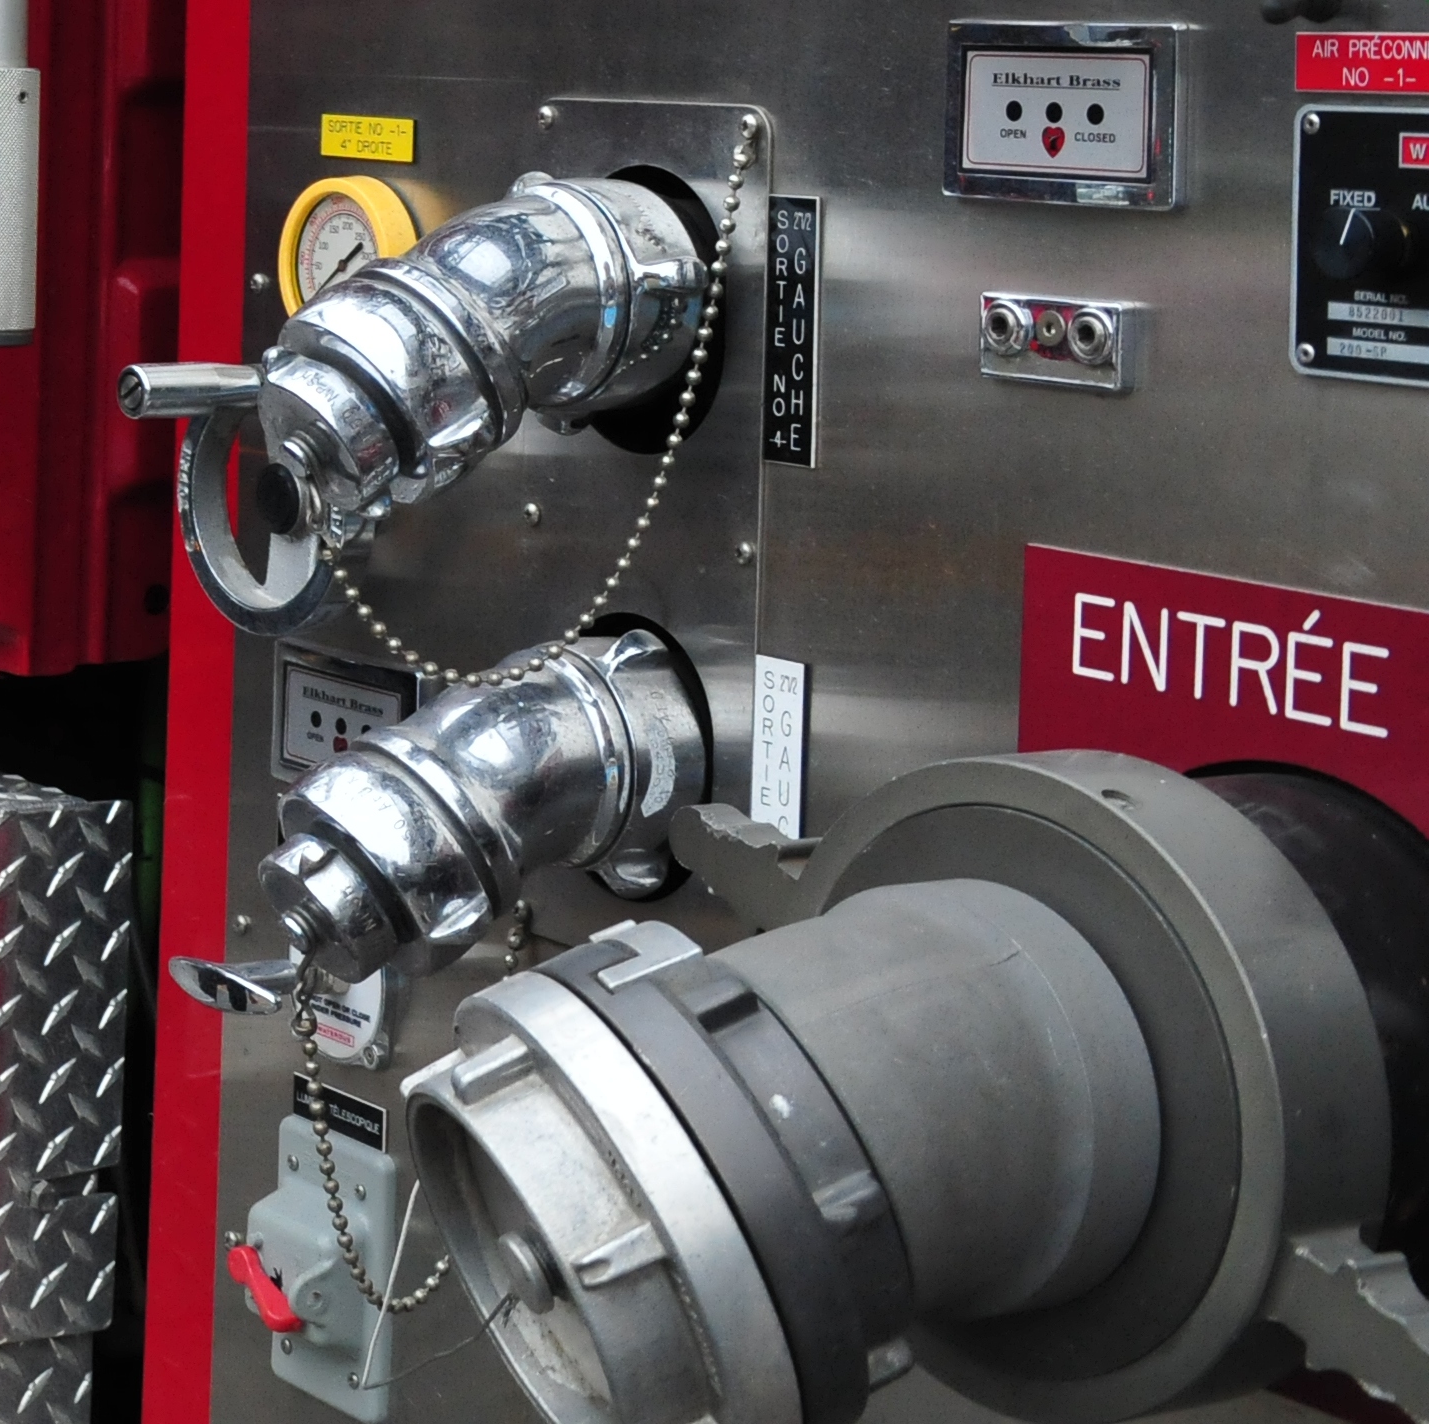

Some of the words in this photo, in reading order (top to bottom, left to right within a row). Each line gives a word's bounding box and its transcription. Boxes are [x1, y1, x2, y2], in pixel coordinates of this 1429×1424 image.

[1312, 38, 1339, 58] AIR
[1348, 33, 1429, 60] PRÉCONN
[992, 72, 1065, 87] Elkhart
[1069, 73, 1121, 89] Brass
[1342, 67, 1369, 87] NO
[328, 119, 363, 135] SORTIE
[368, 123, 383, 136] NO
[1000, 128, 1026, 140] OPEN
[1074, 131, 1116, 144] CLOSED
[356, 140, 393, 156] DROITE
[1330, 189, 1376, 207] FIXED
[774, 210, 789, 347] SORTIE
[1354, 290, 1388, 304] SERIAL
[1352, 327, 1386, 340] MODEL
[790, 246, 806, 452] GAUCHE
[772, 373, 786, 417] NO
[1072, 590, 1389, 739] ENTRÉE
[303, 686, 346, 707] Elkhart
[350, 698, 384, 717] Brass
[760, 671, 775, 807] SORTIE
